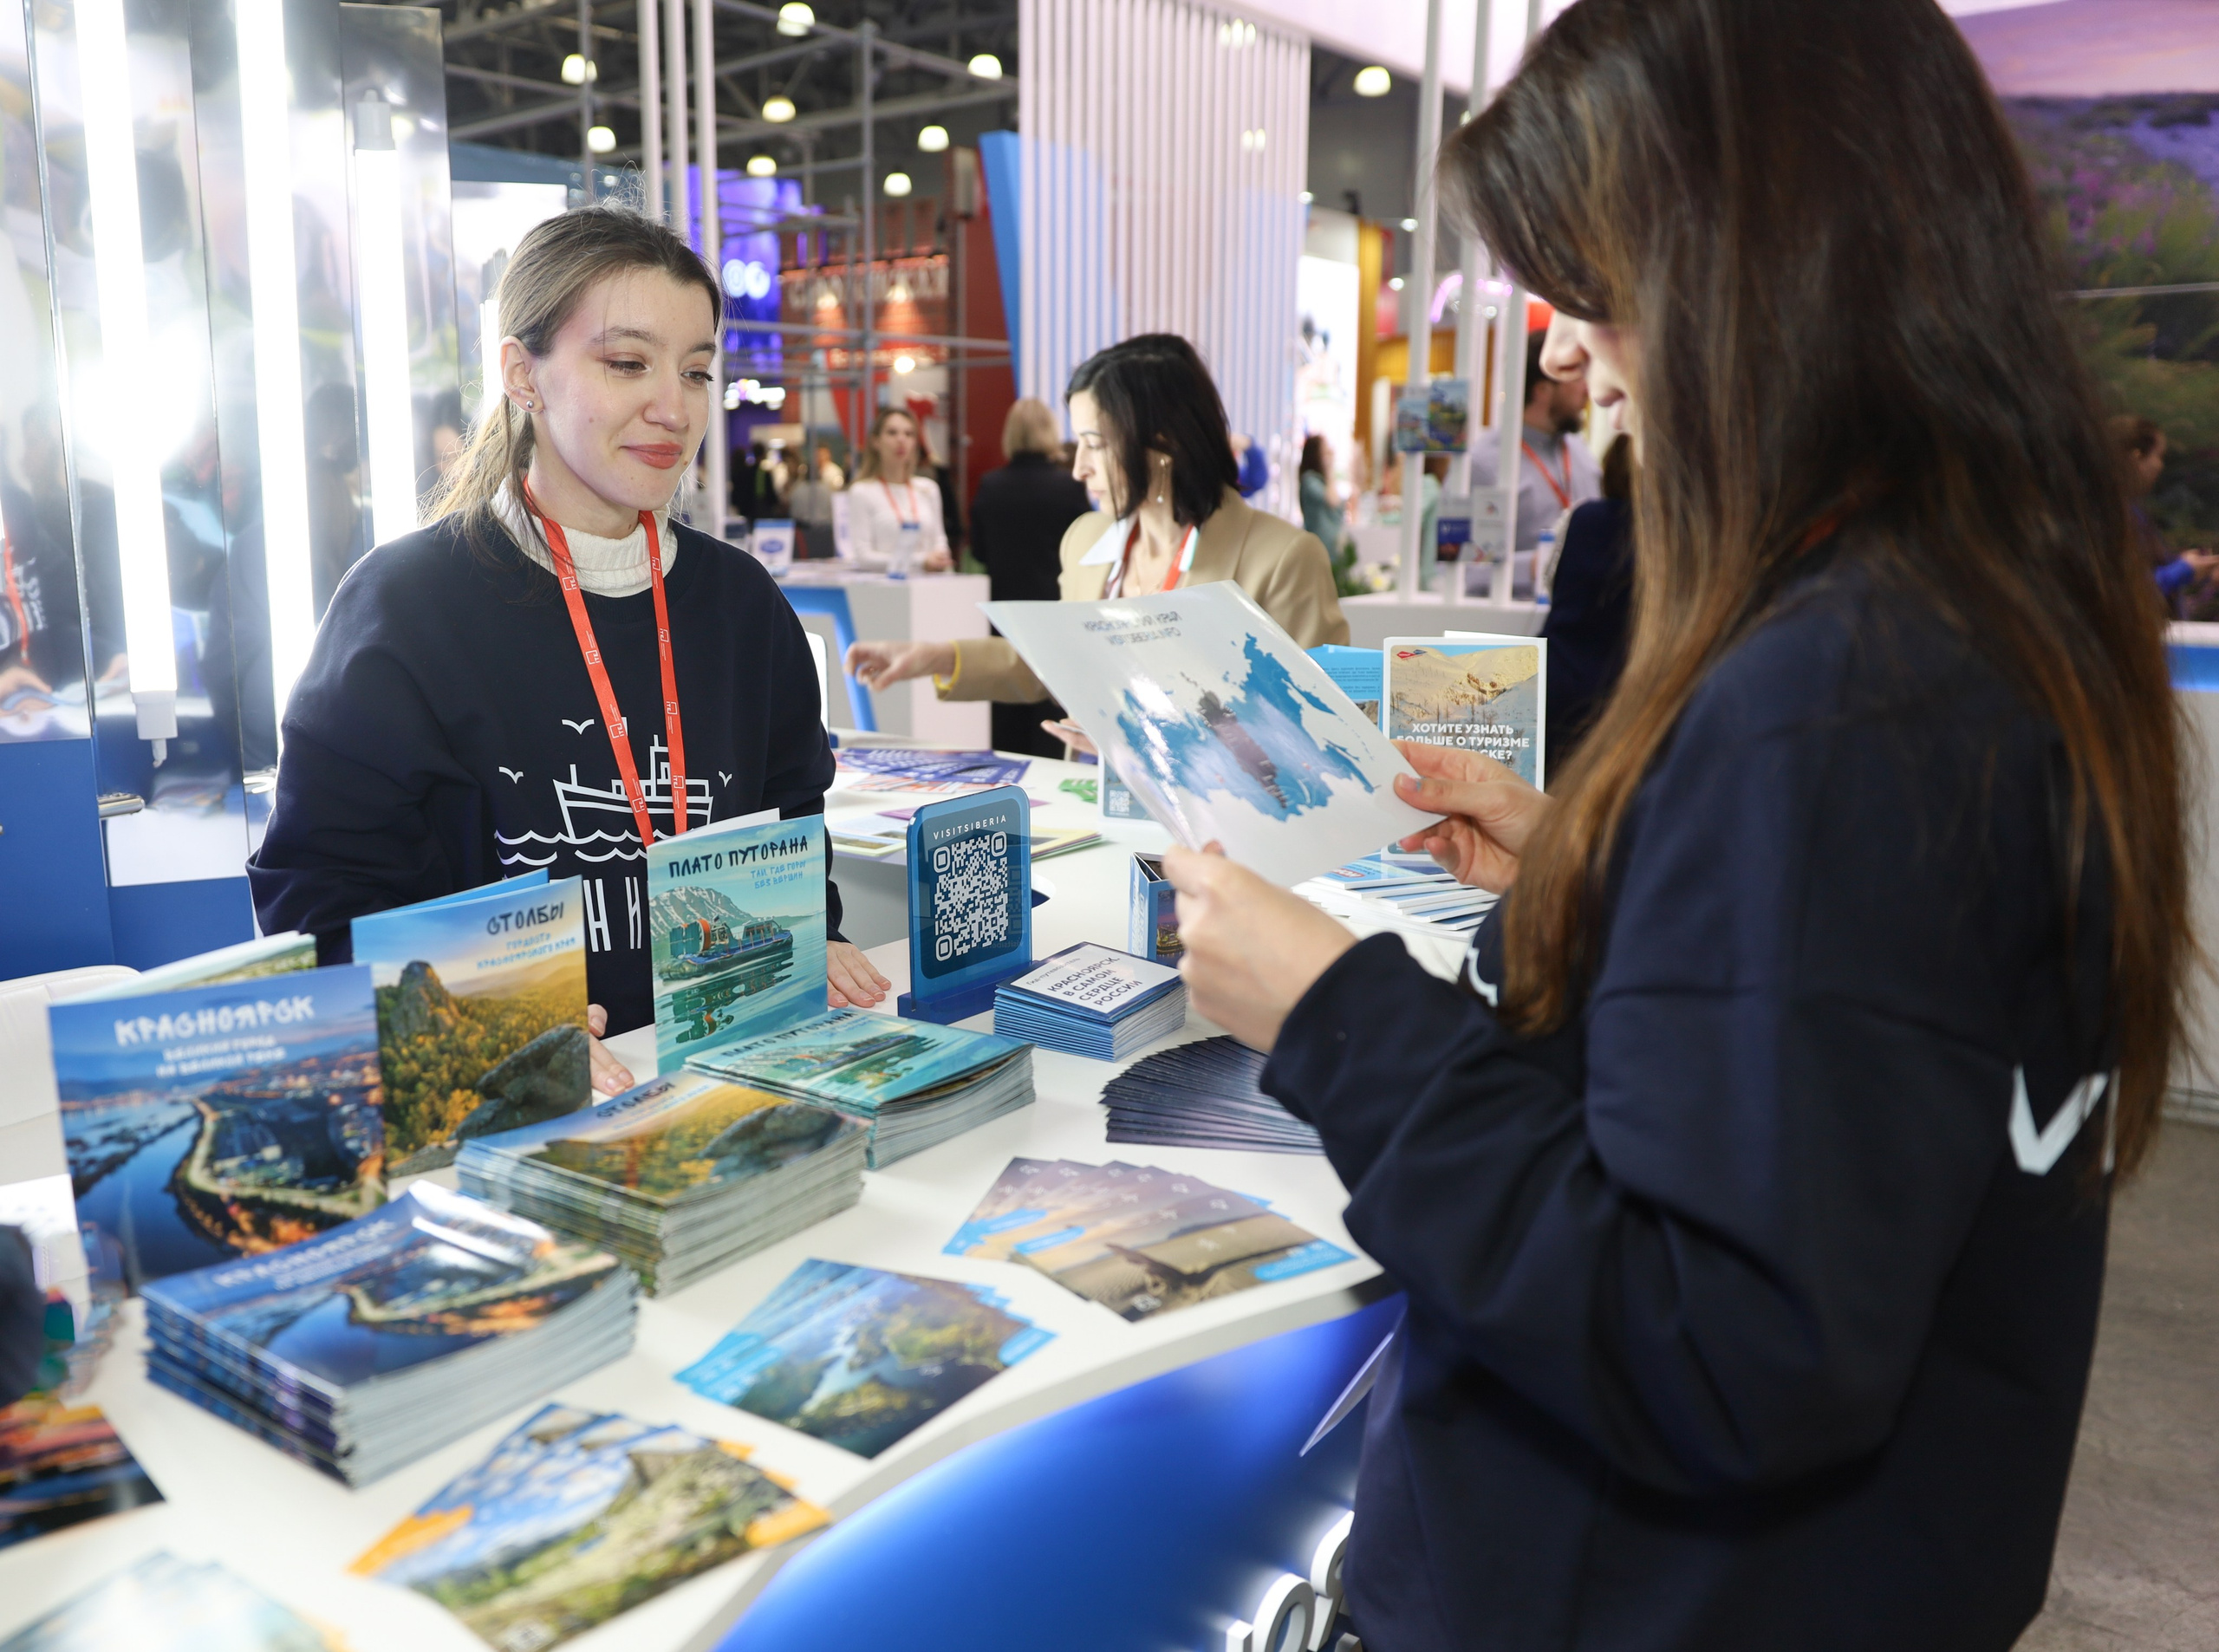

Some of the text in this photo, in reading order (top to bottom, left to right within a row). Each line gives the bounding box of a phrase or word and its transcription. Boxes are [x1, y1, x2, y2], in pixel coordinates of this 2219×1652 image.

[1412, 723, 1514, 735] ХОТИТЕ УЗНАТЬ
[1456, 736, 1467, 745] О
[1468, 737, 1530, 748] ТУРИЗМЕ
[933, 814, 1007, 840] VISITSIBERIA
[668, 835, 809, 879] ПЛАТО ПУТОРАНА
[486, 901, 564, 935] СТОЛБЫ
[1047, 956, 1121, 993] КРАСНОЯРСК.
[1063, 968, 1117, 998] В САМОМ
[1078, 976, 1124, 1002] СЕРДЦЕ
[1093, 979, 1143, 1006] РОССИИ
[114, 994, 316, 1047] КРАСНОЯРСК
